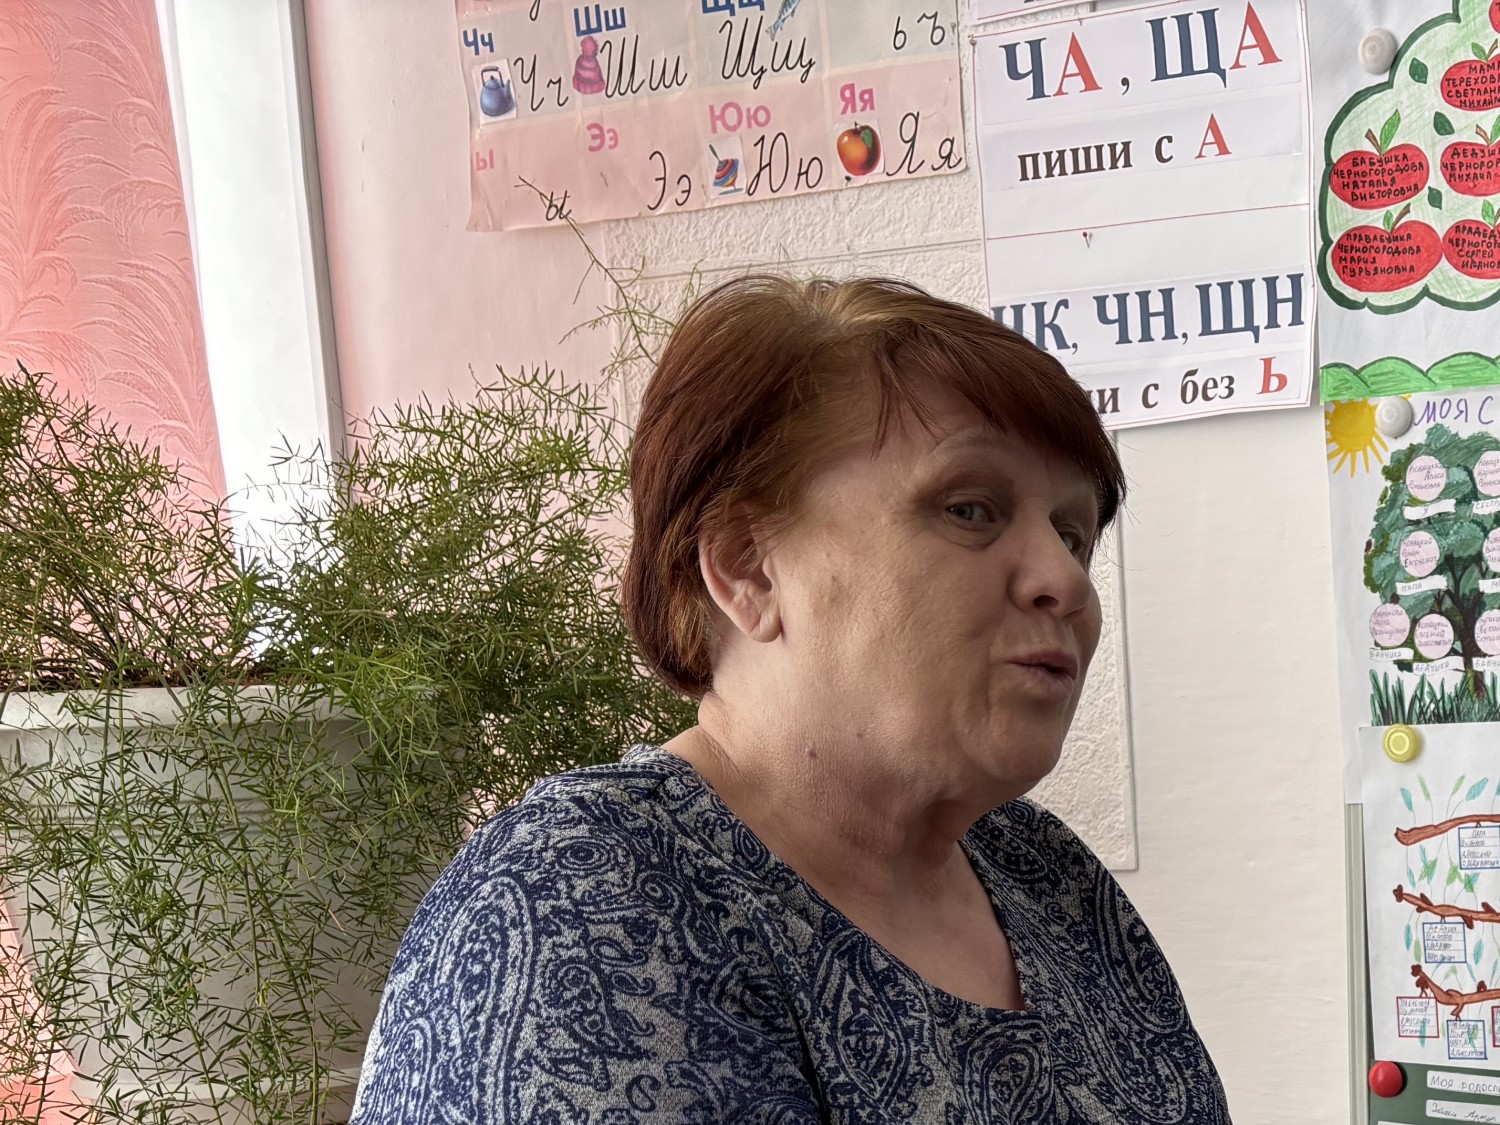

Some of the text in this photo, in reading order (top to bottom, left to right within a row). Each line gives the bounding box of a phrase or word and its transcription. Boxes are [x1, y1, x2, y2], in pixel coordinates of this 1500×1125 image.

[573, 6, 627, 36] Шш
[1145, 1, 1283, 88] ЩА
[839, 83, 875, 115] Яя
[709, 103, 771, 134] Юю
[587, 122, 619, 152] Ээ
[1018, 113, 1232, 181] пиши с А
[1333, 162, 1424, 179] ЧЕРНОГОРОДОВА
[1352, 154, 1409, 168] БАБУШКА
[1342, 178, 1397, 190] НАТАЛЬЯ
[1351, 184, 1419, 202] ВИКТОРОВНА
[1457, 249, 1494, 261] СЕРГЕЙ
[1142, 383, 1159, 408] с
[1181, 370, 1235, 404] без
[1414, 400, 1470, 427] МОЯ
